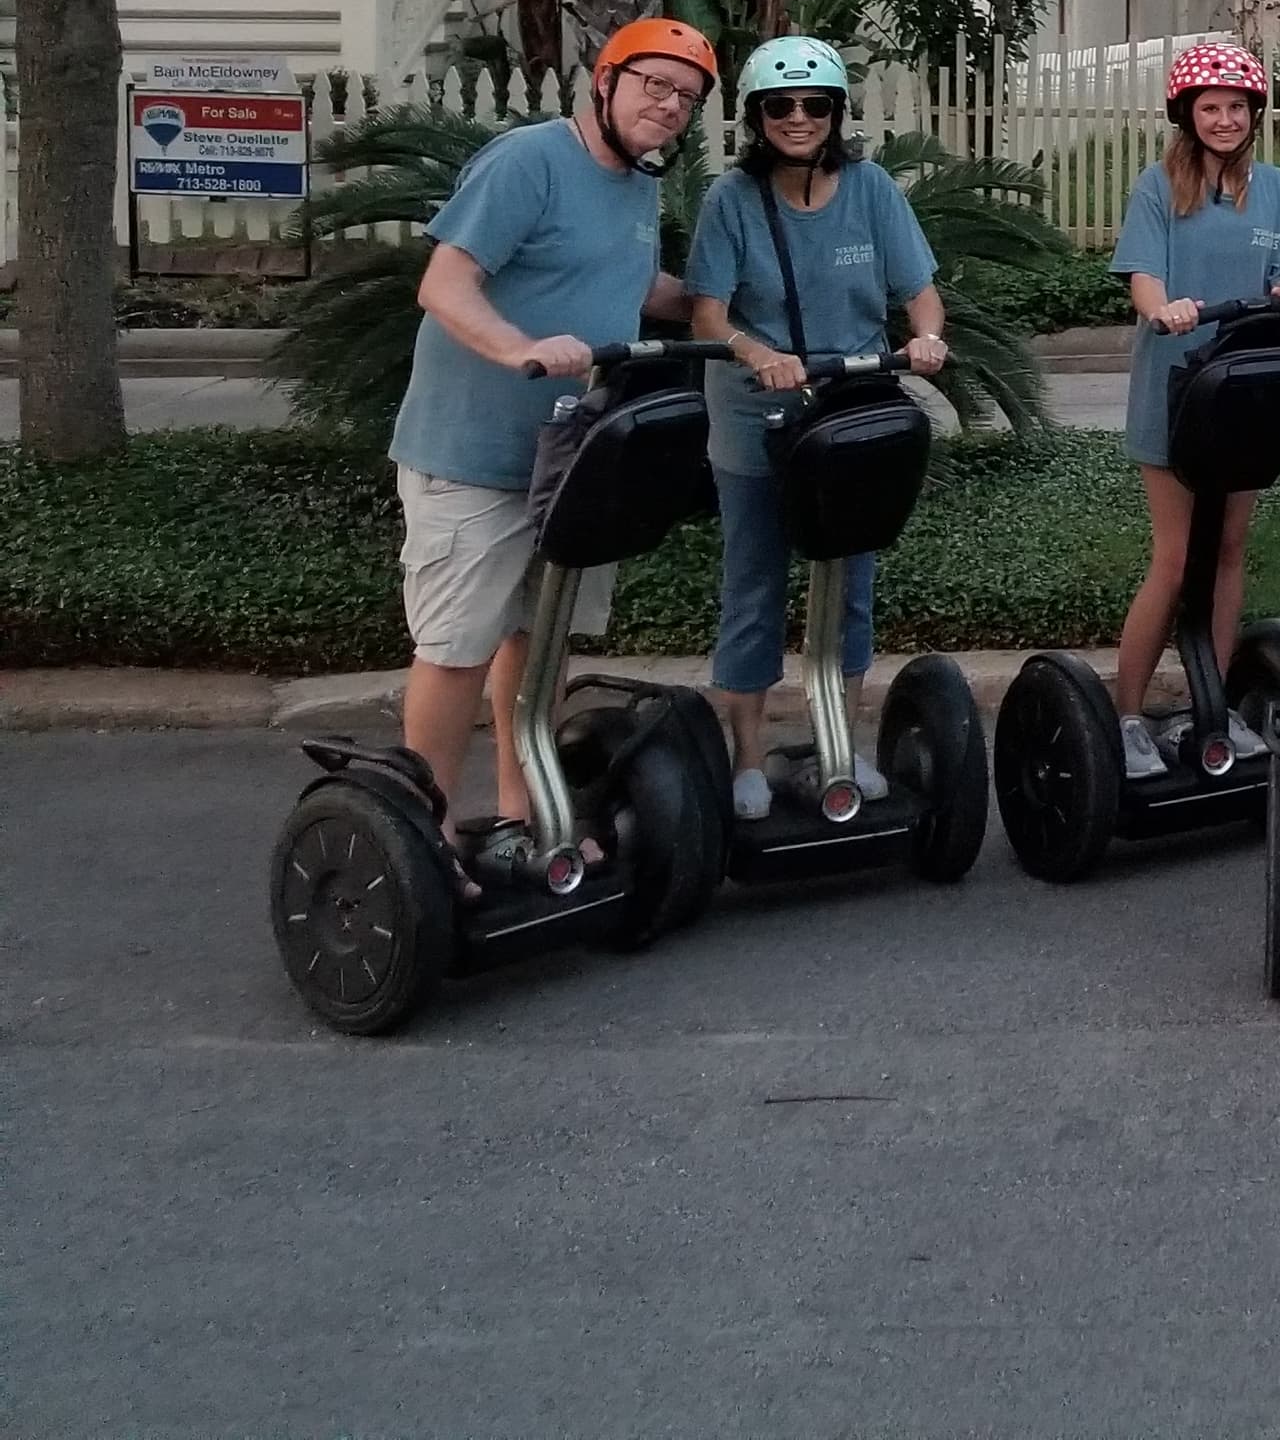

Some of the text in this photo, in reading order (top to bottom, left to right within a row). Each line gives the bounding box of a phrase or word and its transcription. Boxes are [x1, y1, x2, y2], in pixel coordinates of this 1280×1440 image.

[153, 65, 279, 81] Bain McEldowney
[201, 106, 257, 119] For Sale
[184, 131, 289, 146] Steve Ouellette
[185, 162, 226, 176] Metro
[834, 251, 874, 266] AGGIE
